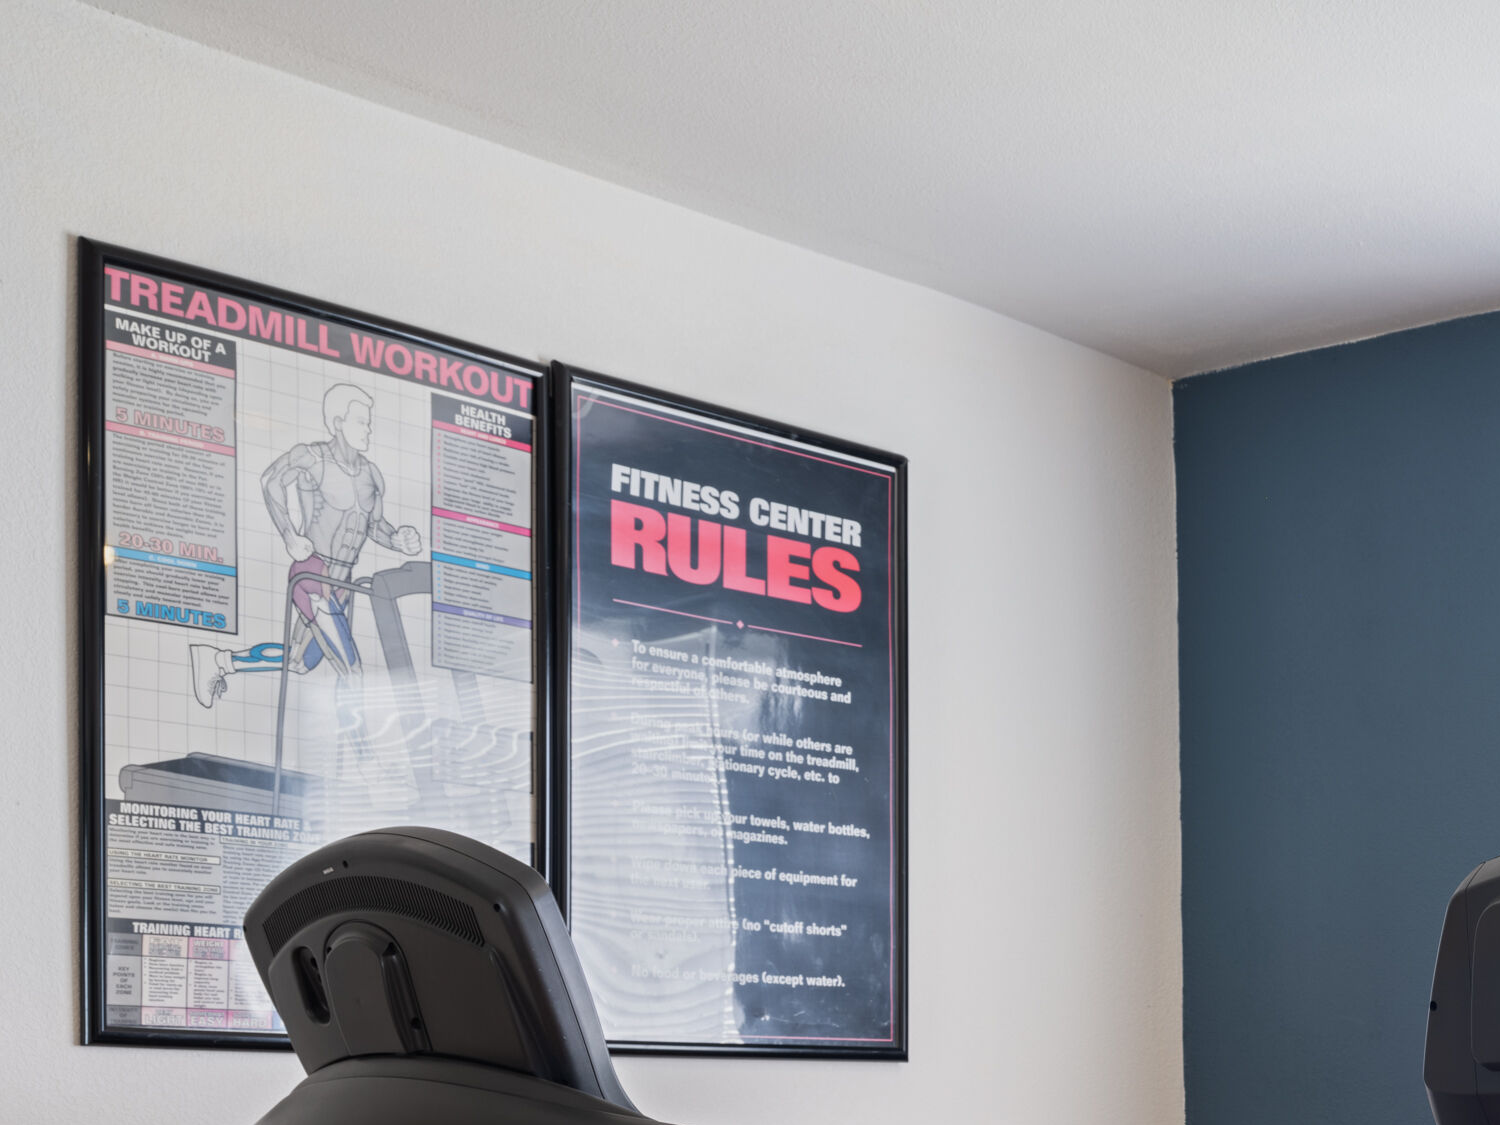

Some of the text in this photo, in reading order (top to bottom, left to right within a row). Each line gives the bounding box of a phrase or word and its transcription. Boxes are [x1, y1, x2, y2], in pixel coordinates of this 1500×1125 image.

[105, 267, 534, 410] TREADMILL WORKOUT
[115, 317, 226, 355] MAKE UP OF A
[131, 333, 211, 362] WORKOUT
[116, 406, 128, 422] 5
[134, 409, 225, 442] MINUTES
[454, 414, 512, 439] BENEFITS
[461, 404, 506, 426] HEALTH
[611, 463, 862, 548] FITNESS CENTER
[119, 531, 173, 554] 20-30
[179, 541, 224, 564] MIN.
[610, 499, 863, 614] RULES
[117, 598, 227, 629] 5 MINUTES
[632, 639, 842, 687] To ensure a comfortable atmosphere
[632, 656, 852, 705] for everyone, please be courteous and
[742, 729, 759, 743] (or
[762, 732, 793, 747] while
[796, 736, 832, 753] others
[834, 743, 853, 756] are
[740, 744, 765, 759] time
[768, 751, 782, 761] on
[785, 751, 804, 764] the
[807, 754, 860, 773] treadmill,
[767, 765, 801, 780] cycle,
[804, 770, 825, 783] etc.
[828, 772, 841, 785] to
[109, 814, 176, 831] SELECTING
[179, 820, 201, 832] THE
[204, 823, 234, 836] BEST
[236, 826, 290, 840] TRAINING
[120, 802, 198, 821] MONITORING
[201, 810, 231, 824] YOUR
[235, 813, 271, 827] HEART
[274, 817, 300, 831] RATE
[750, 813, 790, 832] towels,
[792, 820, 825, 833] water
[828, 821, 871, 839] bottles,
[726, 830, 788, 845] magazines.
[730, 865, 762, 880] piece
[764, 868, 776, 880] of
[779, 869, 838, 887] equipment
[840, 874, 858, 887] for
[132, 922, 190, 936] TRAINING
[194, 925, 231, 938] HEART
[742, 918, 761, 931] (no
[763, 919, 804, 934] "cutoff
[806, 921, 848, 937] shorts"
[762, 971, 804, 988] (except
[806, 975, 847, 988] water).
[190, 1016, 223, 1026] EASY
